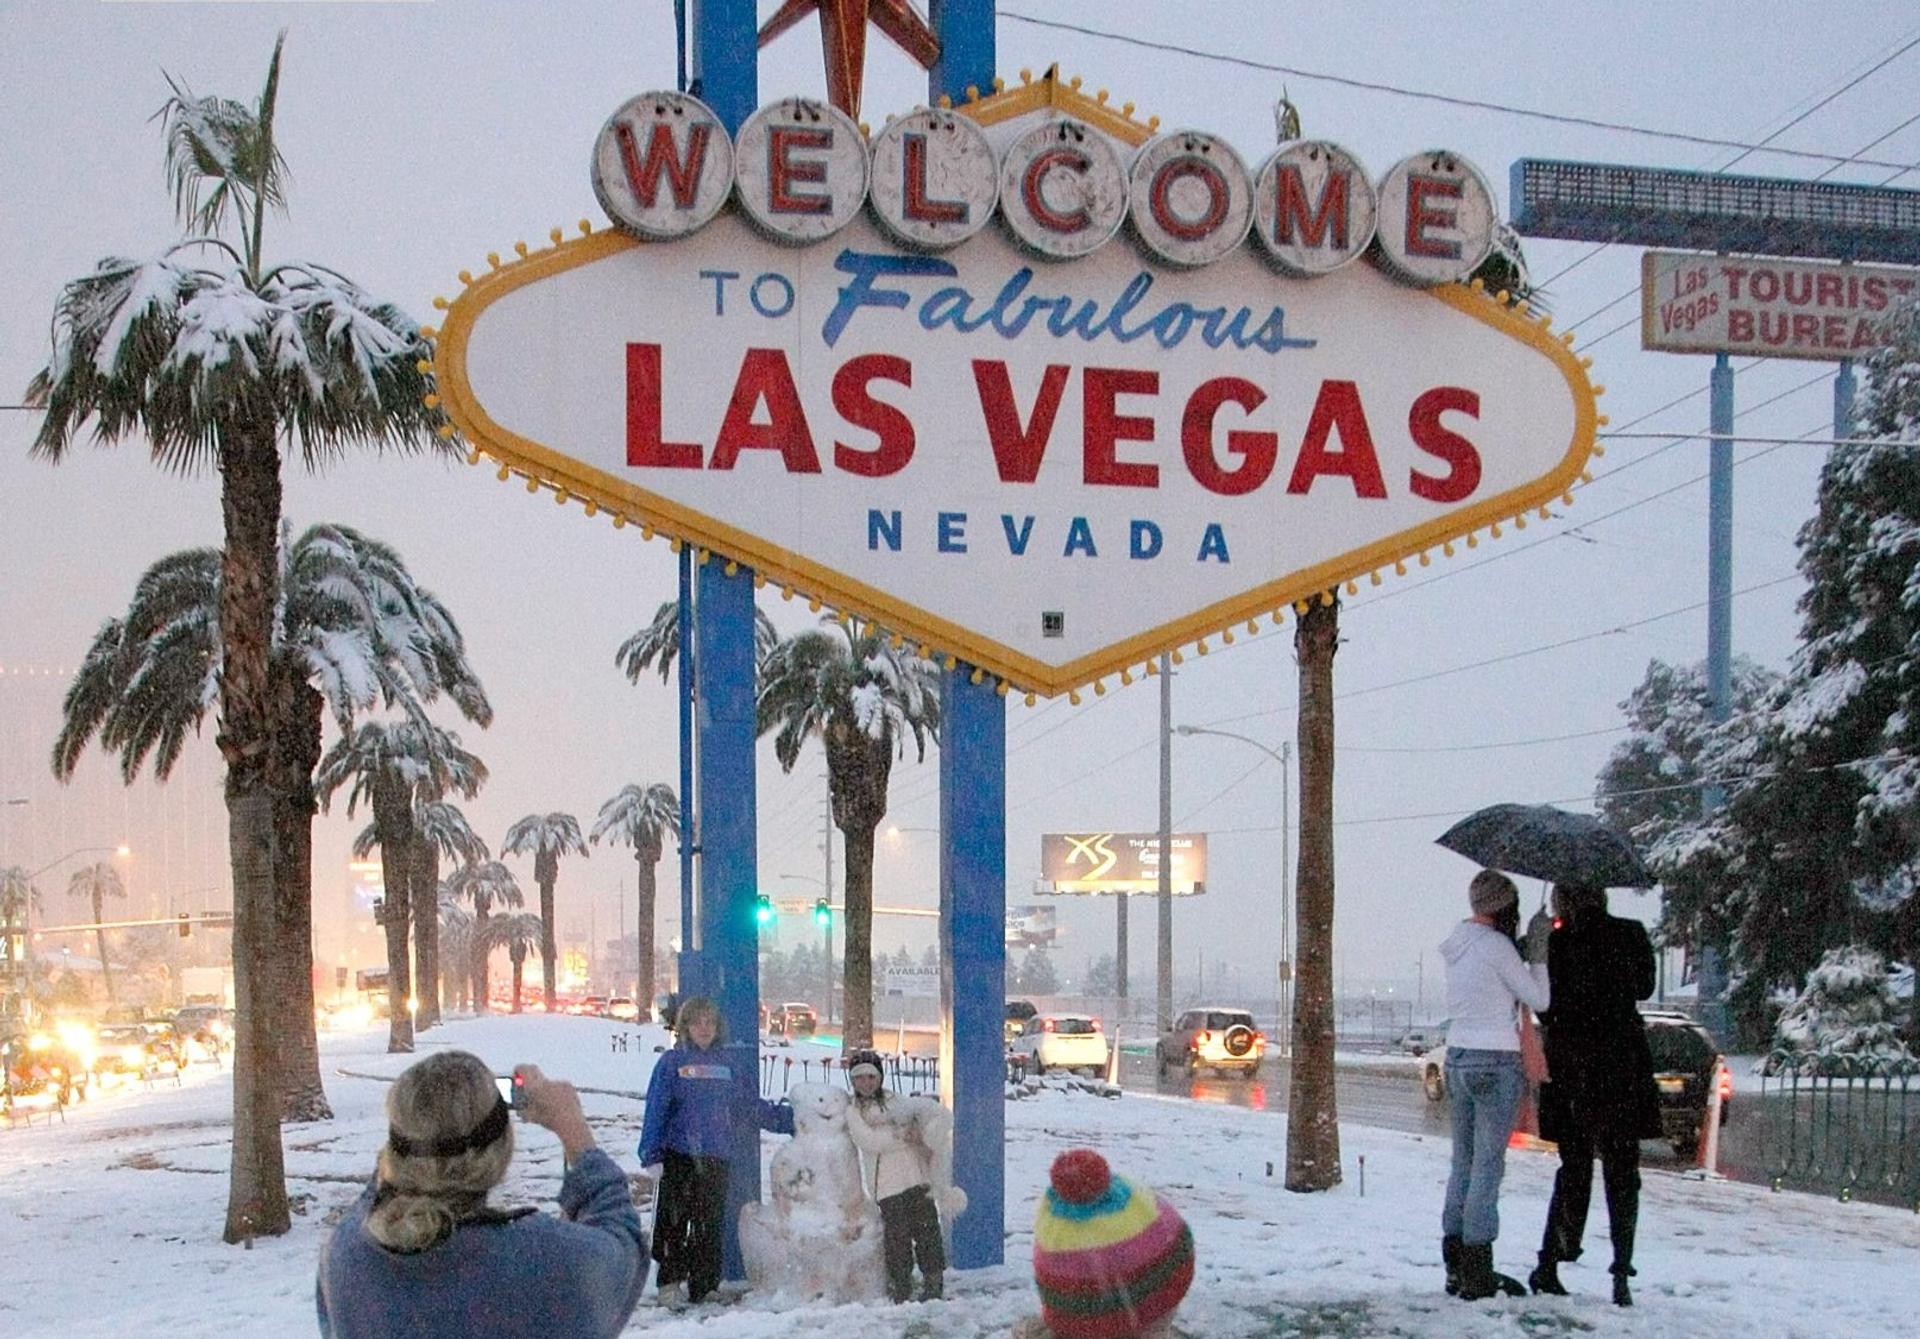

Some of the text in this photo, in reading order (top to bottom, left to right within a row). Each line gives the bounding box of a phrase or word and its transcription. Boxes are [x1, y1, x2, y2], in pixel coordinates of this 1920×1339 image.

[614, 121, 1467, 261] WELCOME
[699, 247, 1318, 354] TO Fabulous
[1673, 265, 1710, 300] Las
[1722, 264, 1917, 312] TOURIST
[1659, 290, 1720, 335] Vegas
[626, 342, 1482, 503] LAS VEGAS
[867, 508, 1232, 564] NEVADA
[1064, 833, 1117, 880] XS
